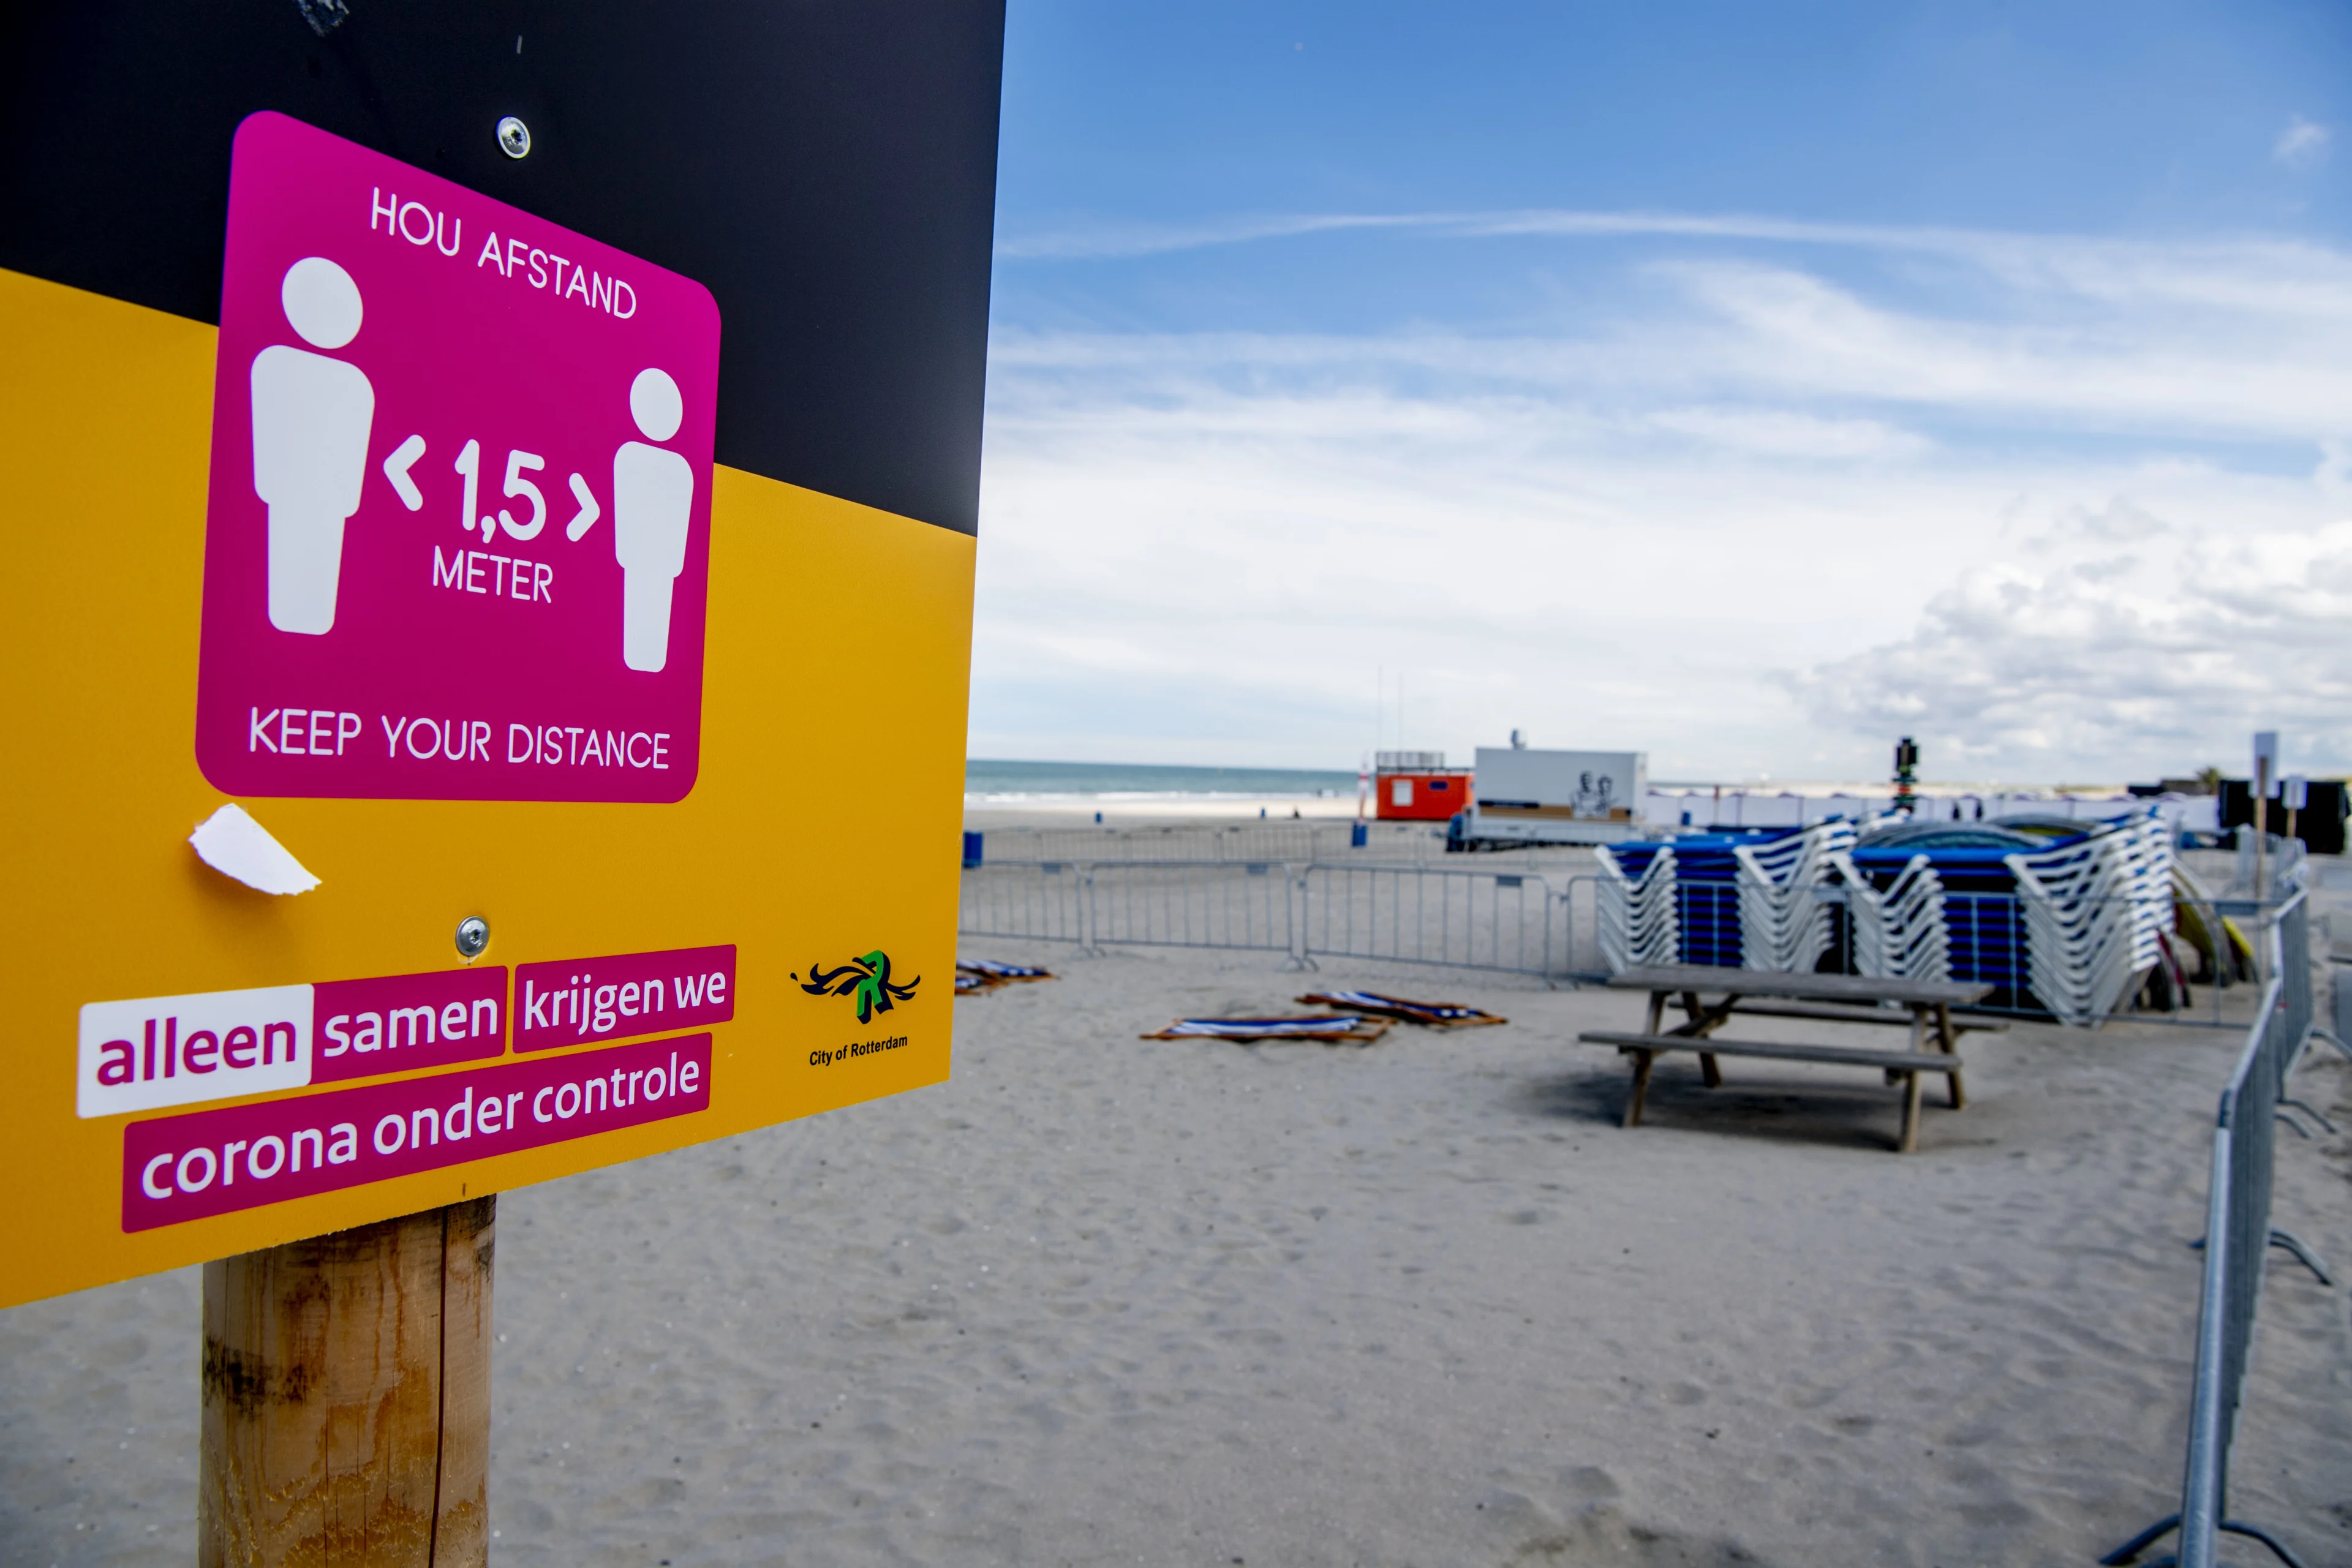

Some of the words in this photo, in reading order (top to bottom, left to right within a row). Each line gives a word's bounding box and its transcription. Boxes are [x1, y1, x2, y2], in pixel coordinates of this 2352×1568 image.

[371, 187, 461, 257] HOU
[477, 232, 637, 319] AFSTAND
[454, 439, 546, 544] 1,5
[432, 545, 553, 603] METER
[249, 706, 362, 756] KEEP
[381, 715, 491, 763] YOUR
[507, 723, 671, 769] DISTANCE
[96, 1016, 297, 1087] alleen
[323, 998, 498, 1057] samen
[524, 974, 665, 1036] krijgen
[673, 971, 727, 1009] we
[809, 1050, 834, 1066] City
[835, 1044, 849, 1061] of
[851, 1036, 908, 1058] Rotterdam
[141, 1123, 358, 1199] corona
[373, 1086, 524, 1155] onder
[533, 1052, 700, 1123] controle
